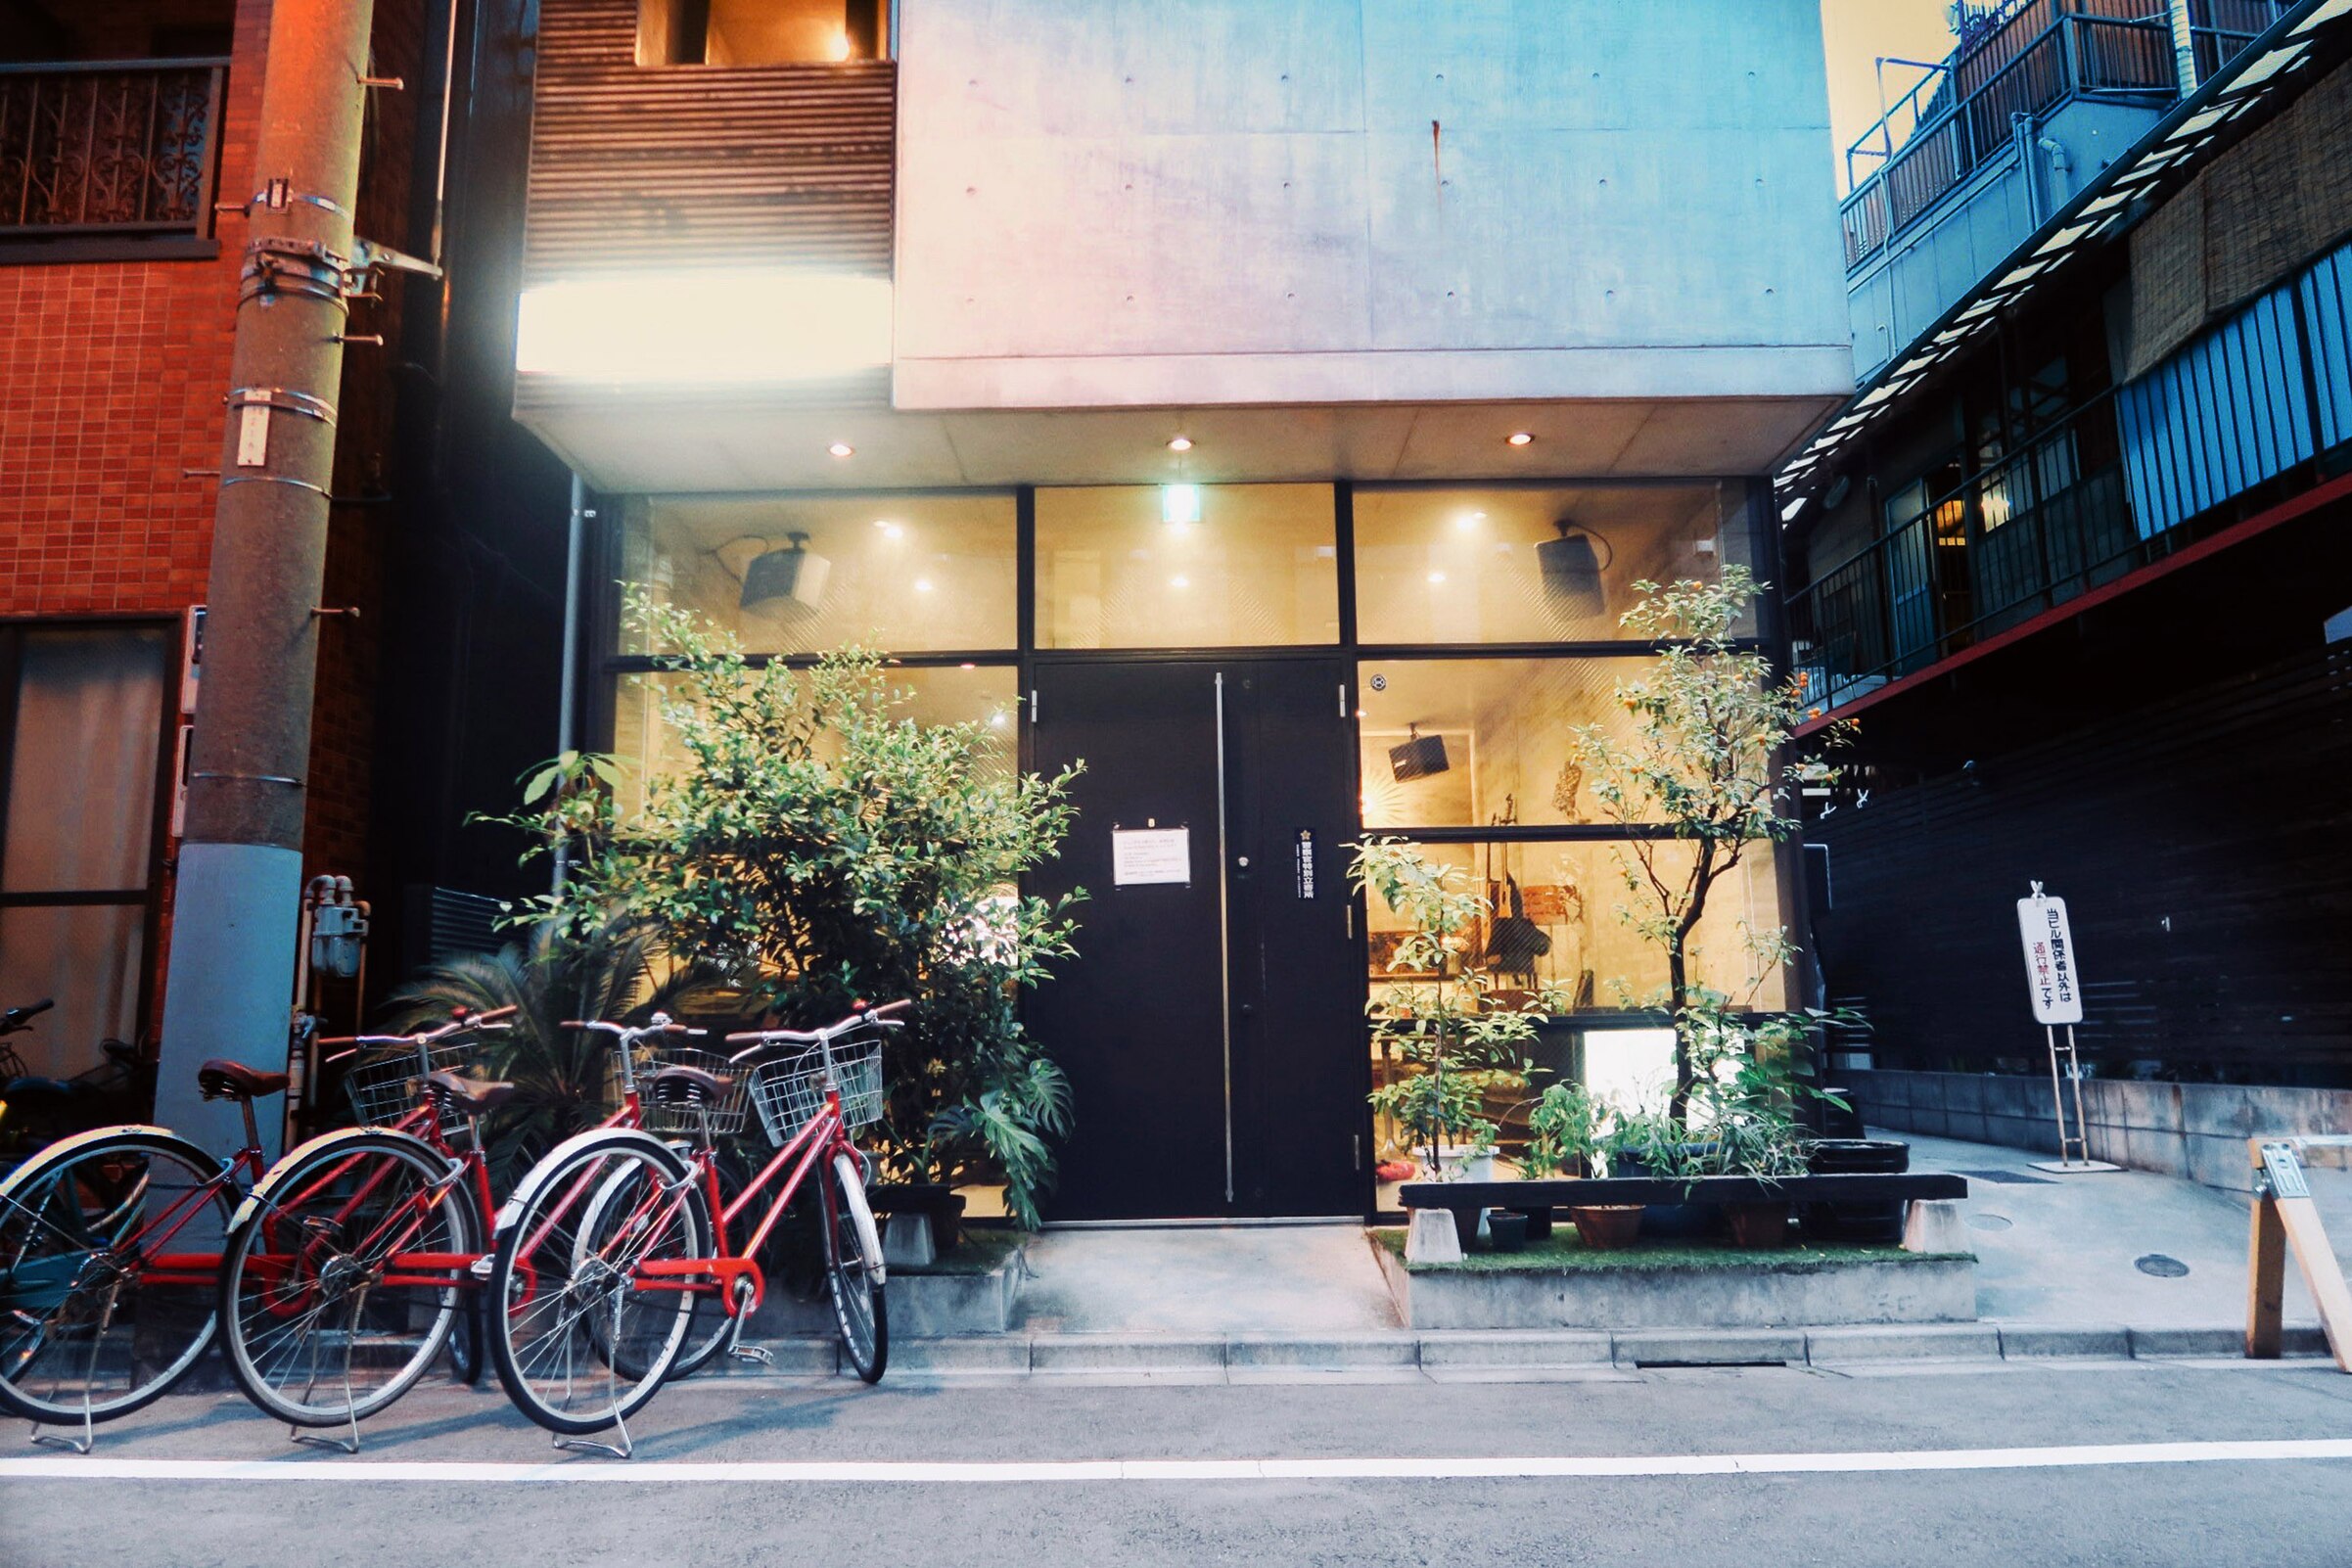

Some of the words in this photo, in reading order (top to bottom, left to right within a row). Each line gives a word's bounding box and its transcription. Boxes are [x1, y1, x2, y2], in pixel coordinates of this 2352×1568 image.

[2033, 942, 2054, 1010] 通行禁止です
